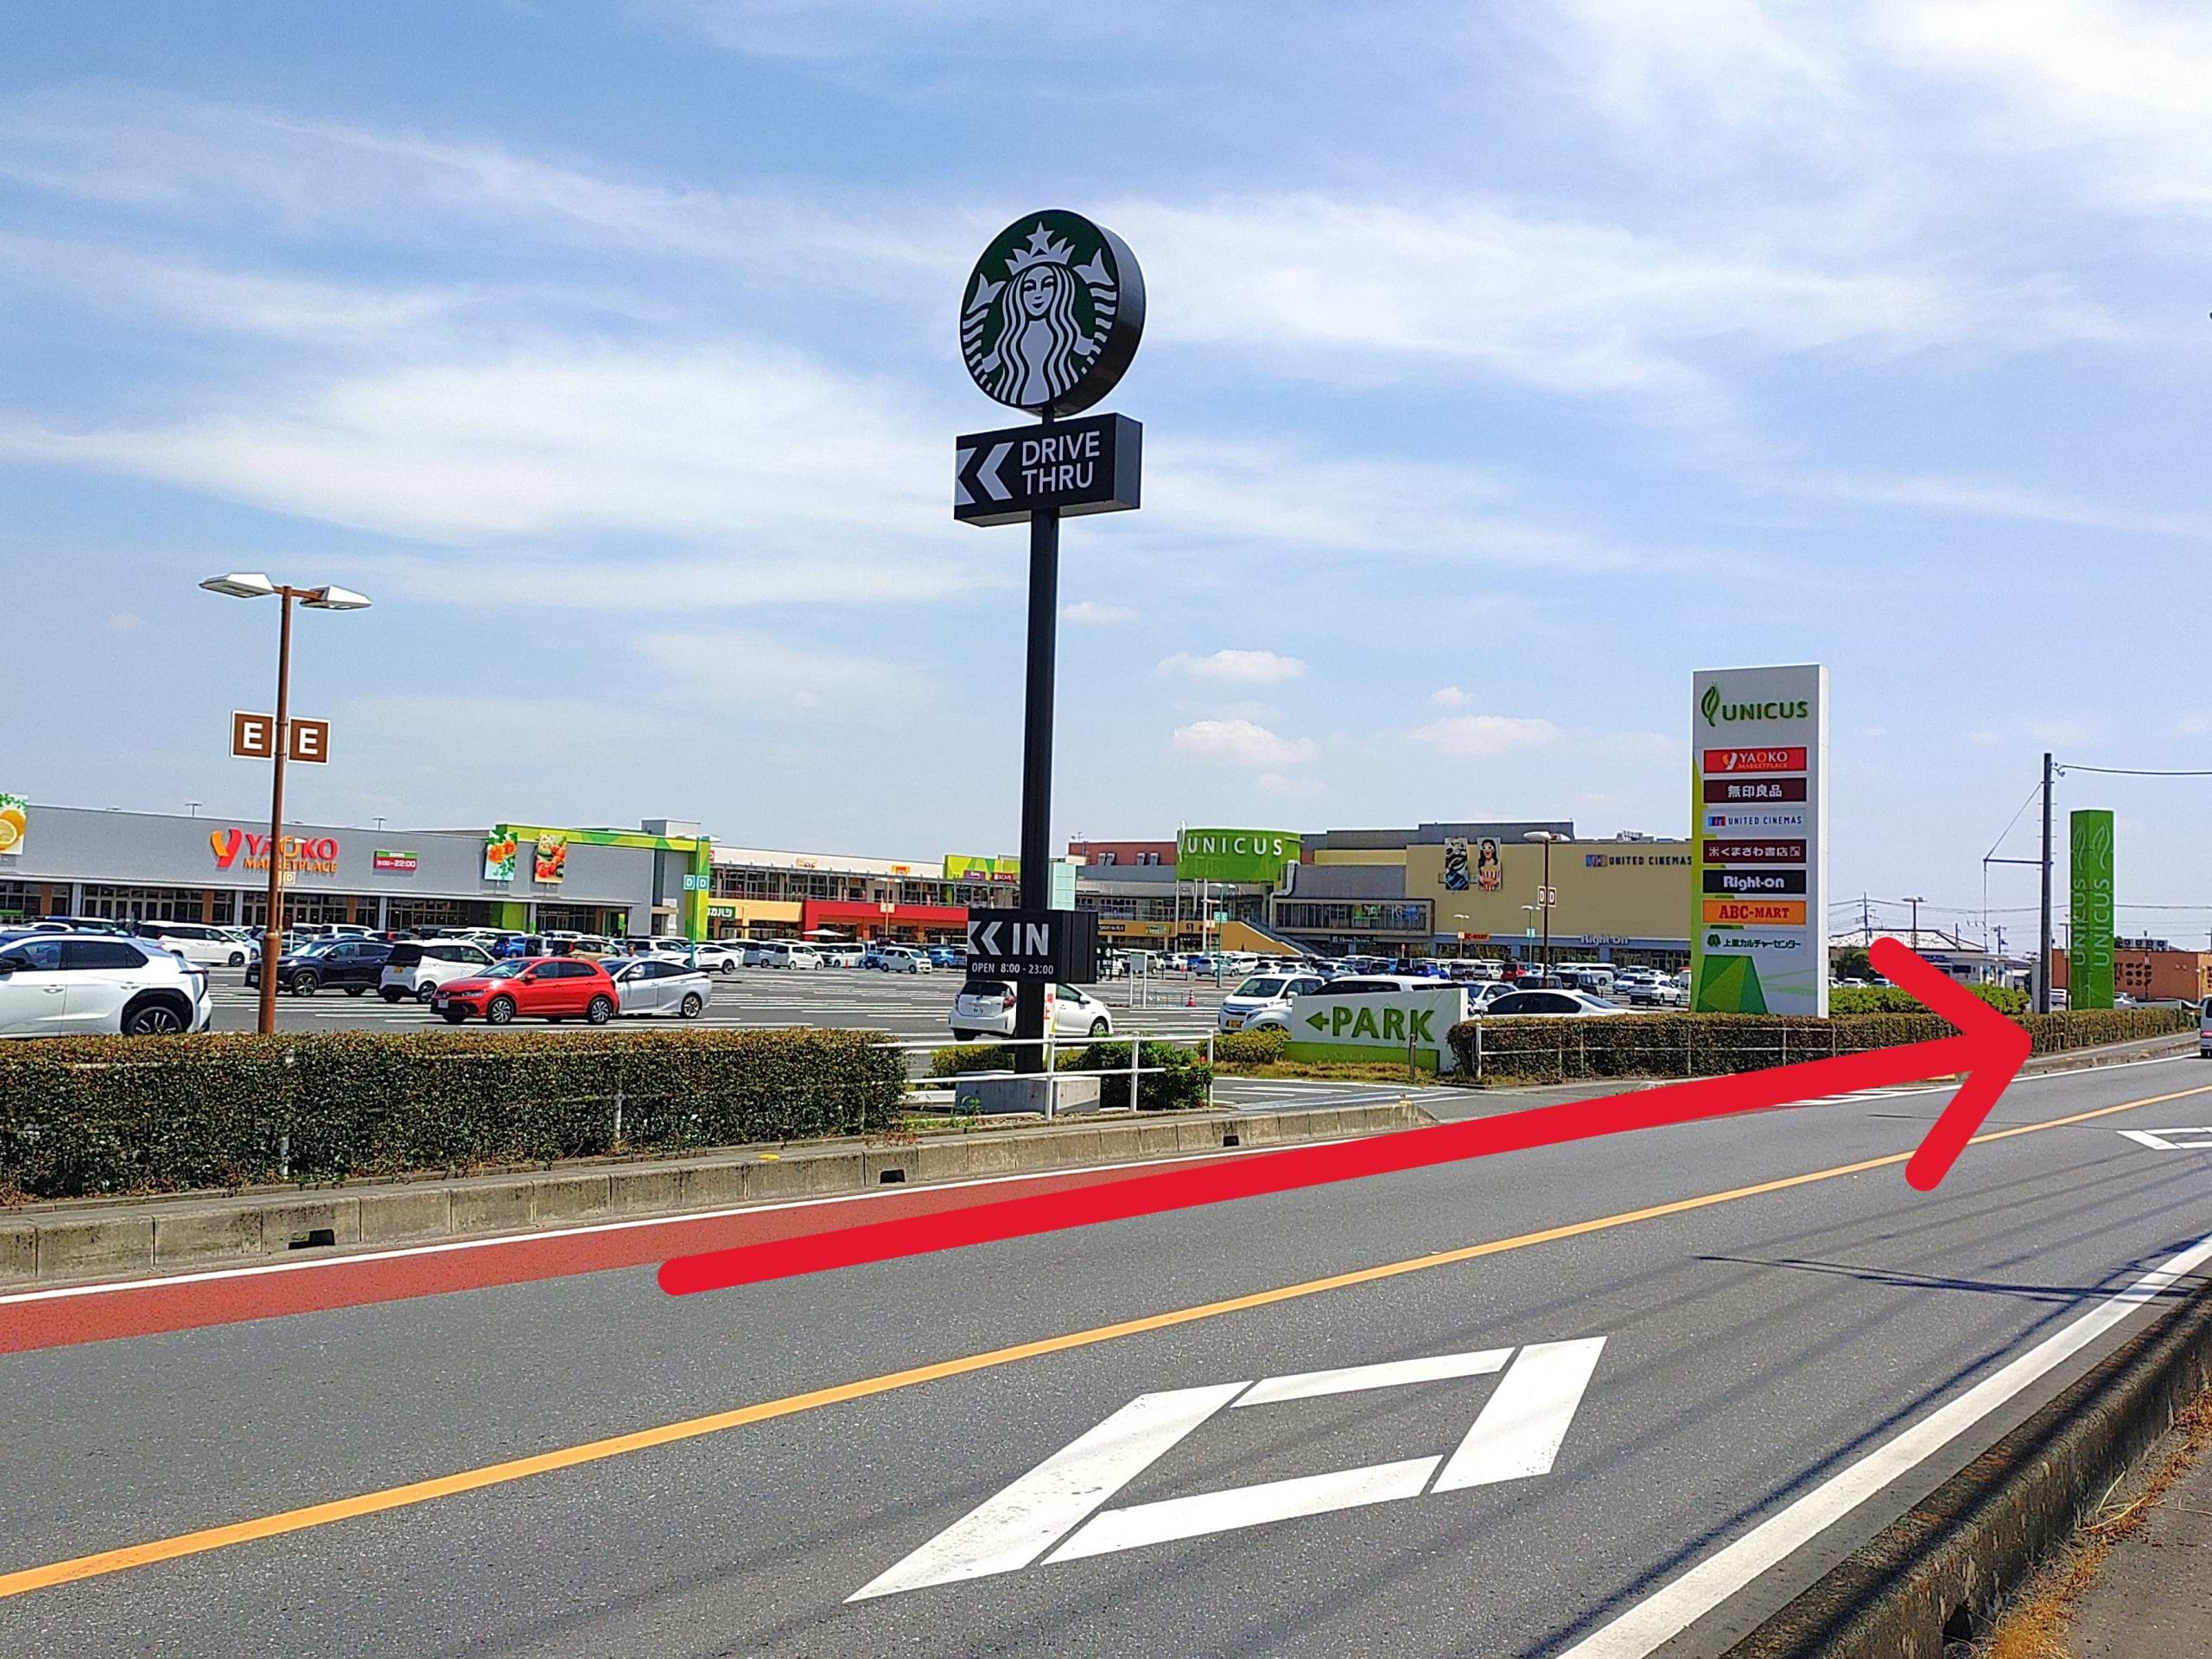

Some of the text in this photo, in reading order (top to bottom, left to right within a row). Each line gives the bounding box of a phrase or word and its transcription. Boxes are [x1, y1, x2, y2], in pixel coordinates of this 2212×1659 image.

[1021, 431, 1100, 467] DRIVE
[1021, 461, 1093, 495] THRU
[1722, 701, 1808, 721] UNICUS
[243, 721, 264, 750] E
[299, 728, 319, 755] E
[1739, 751, 1788, 763] YAOKO
[1727, 784, 1783, 798] 無印良品
[1728, 816, 1802, 825] UNITED CINEMAS
[1187, 836, 1282, 856] UNICUS
[1720, 846, 1789, 857] くまざわ書店
[244, 857, 338, 873] MAETPLACE
[1609, 855, 1692, 866] UNITED CINEMAS
[686, 878, 692, 887] D
[700, 879, 705, 887] D
[1723, 875, 1785, 891] Right-on
[1549, 891, 1554, 903] D
[1719, 905, 1790, 919] ABC-MART
[2094, 879, 2110, 966] UNICUS
[1012, 922, 1049, 956] IN
[1580, 934, 1630, 946] Right-on
[972, 963, 995, 973] OPEN
[1001, 963, 1020, 974] 8:00
[1028, 963, 1054, 975] 23:00
[1332, 1006, 1435, 1042] PARK
